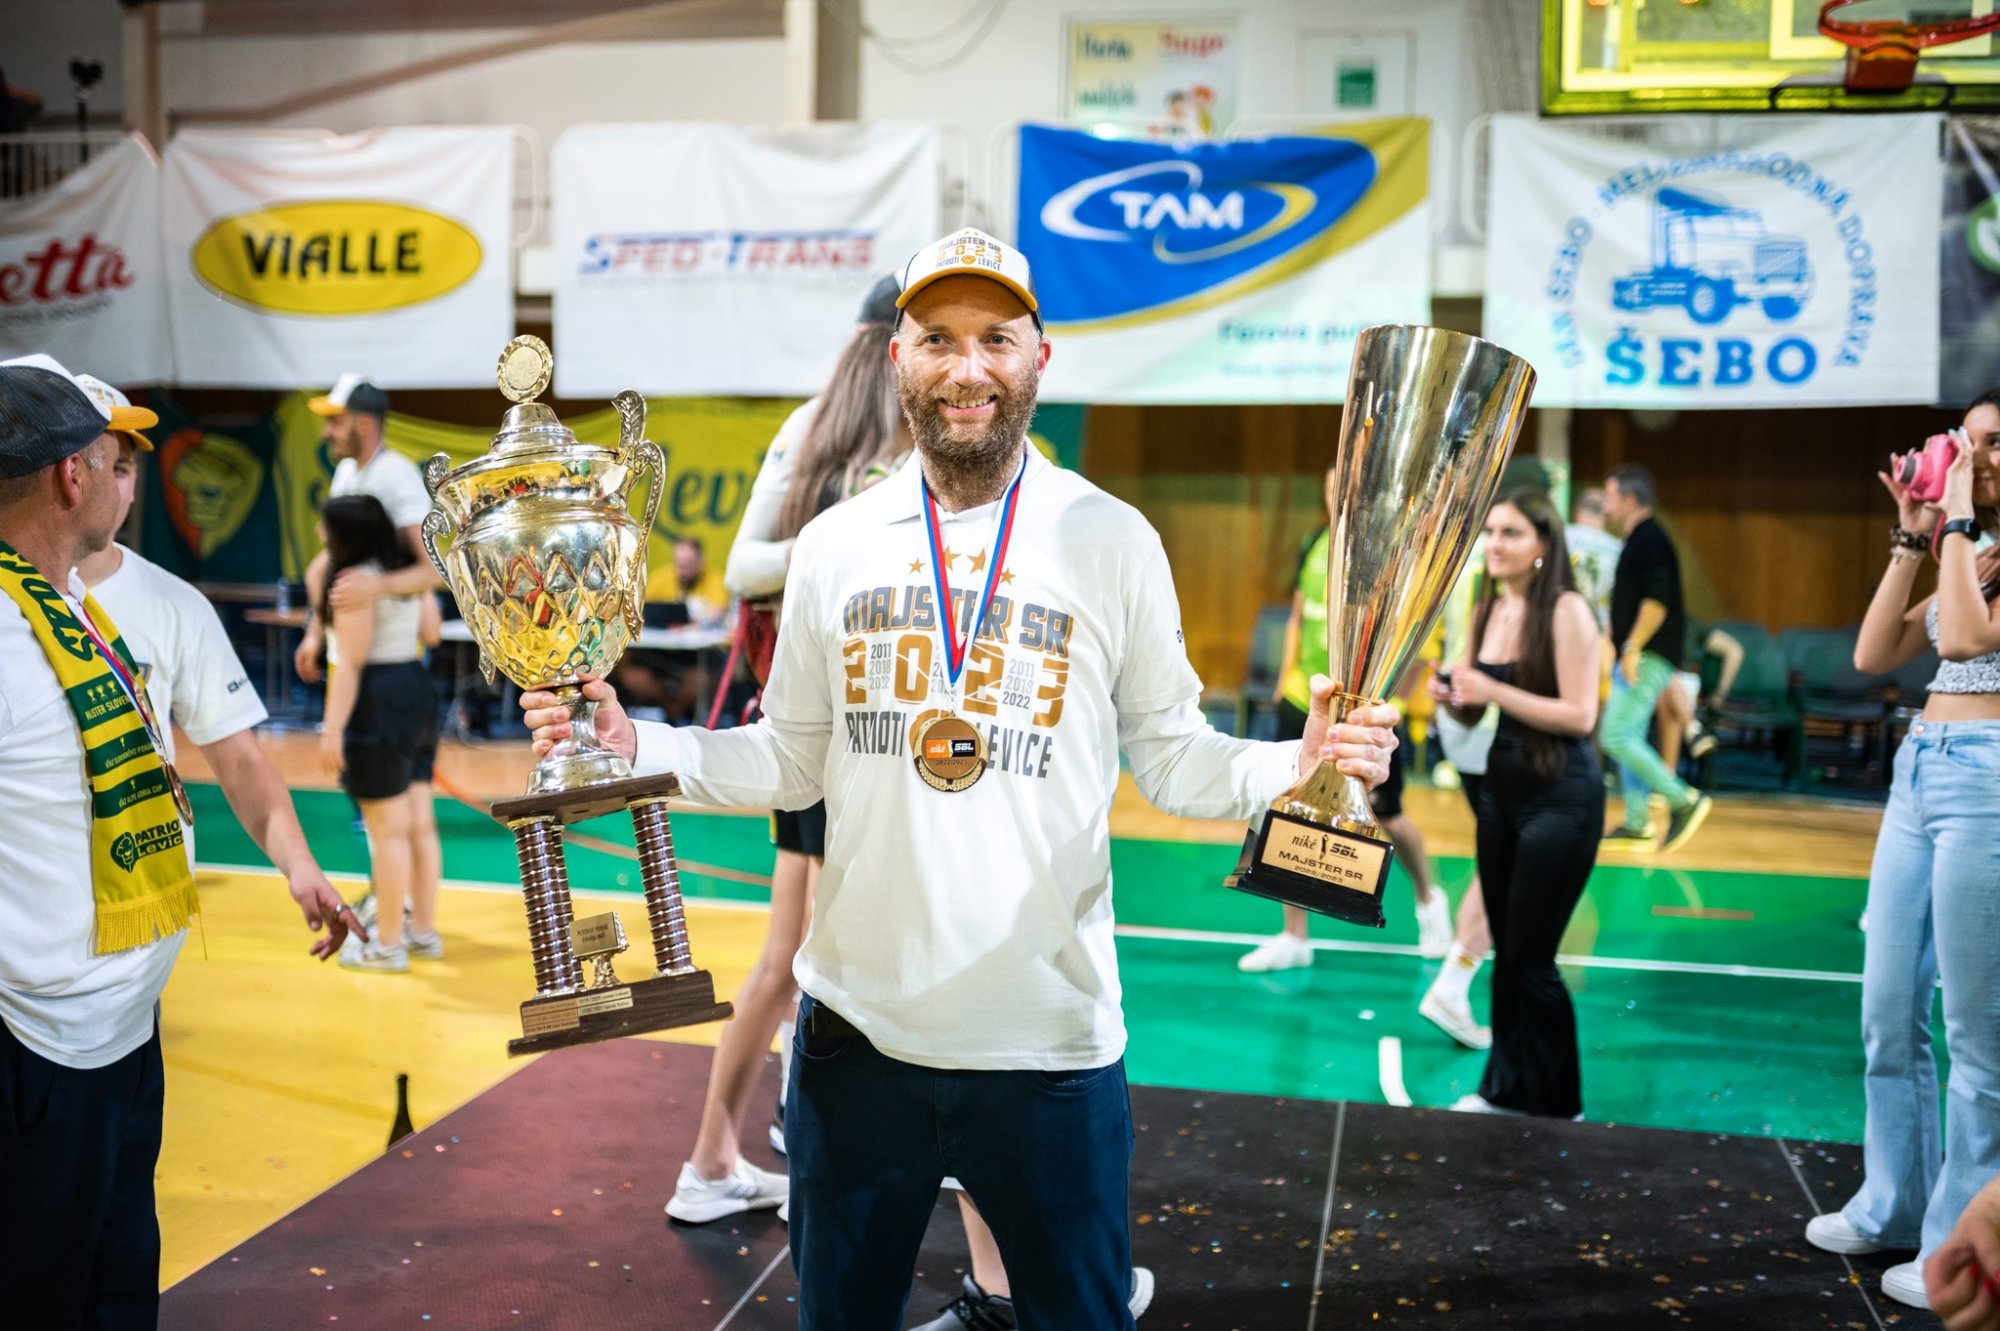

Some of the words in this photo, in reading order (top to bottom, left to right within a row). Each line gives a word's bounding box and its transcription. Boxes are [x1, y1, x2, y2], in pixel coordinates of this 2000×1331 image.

[1110, 191, 1244, 230] TAM
[242, 230, 422, 280] VIALLE
[978, 257, 1001, 271] LEVICE
[1605, 326, 1818, 387] ŠEBO
[1019, 602, 1074, 659] SR
[871, 642, 892, 659] 2011
[869, 659, 892, 676] 2018
[1009, 658, 1035, 679] 2011
[869, 676, 890, 691] 2022
[1006, 675, 1034, 695] 2018
[1002, 691, 1031, 710] 2022
[954, 743, 974, 751] SBL
[134, 818, 180, 844] PATRIO
[1291, 834, 1318, 850] niké
[1330, 843, 1359, 860] SBL
[1278, 850, 1344, 875] MAJSTER
[1345, 870, 1364, 881] SR
[1294, 865, 1343, 883] 2022/2023
